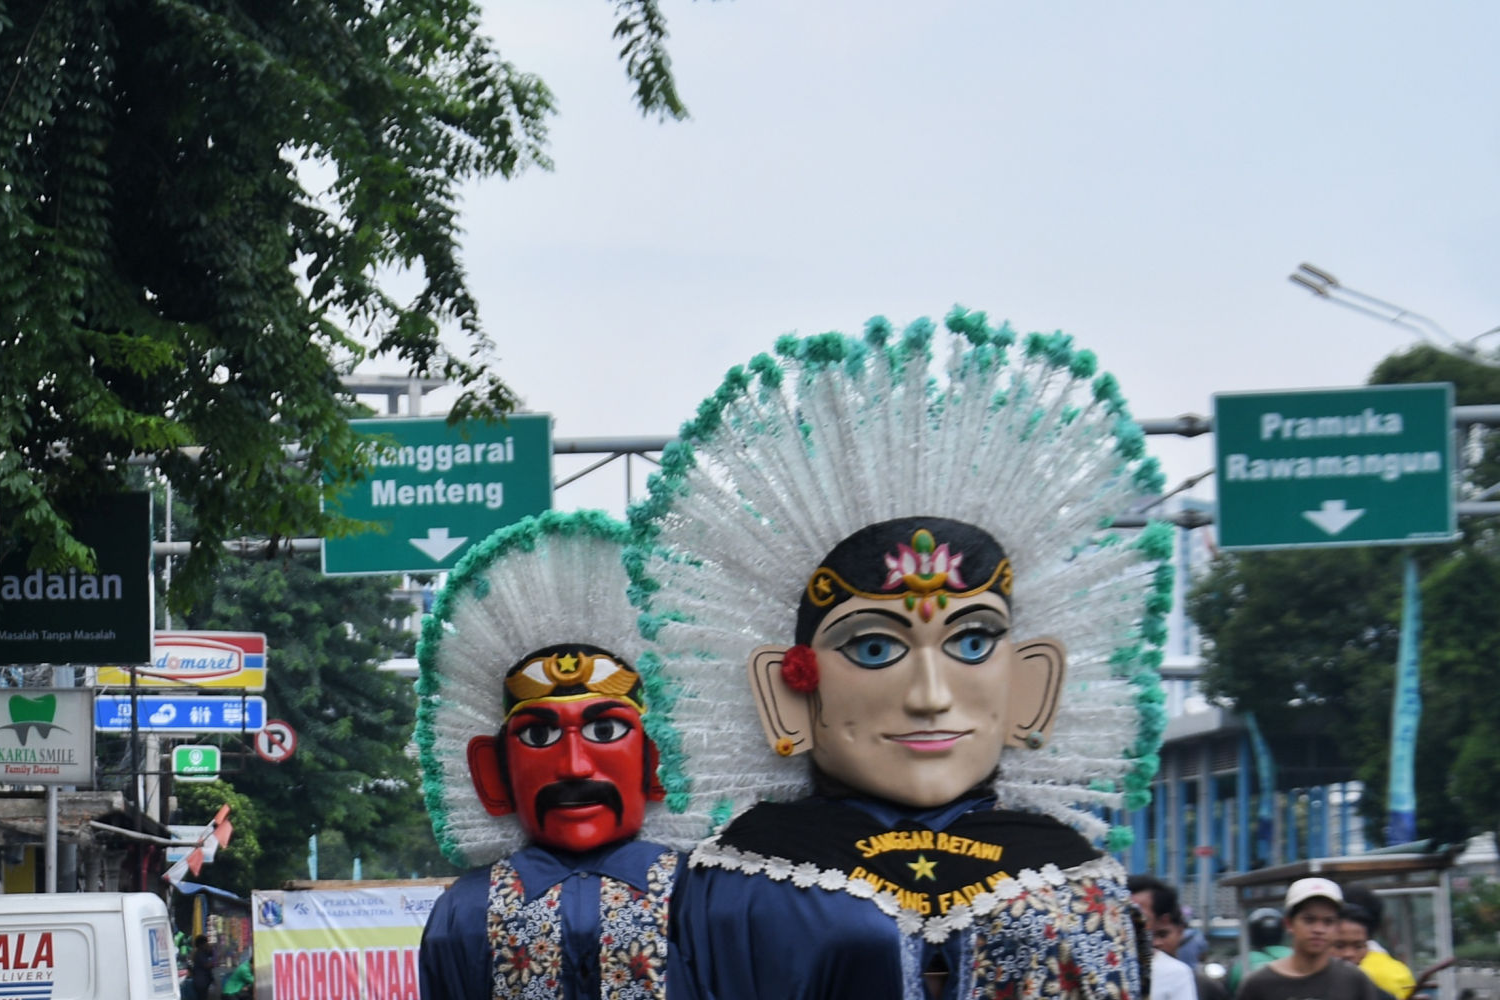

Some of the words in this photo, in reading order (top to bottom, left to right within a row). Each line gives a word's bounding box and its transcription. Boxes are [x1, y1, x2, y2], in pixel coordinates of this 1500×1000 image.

[1260, 408, 1404, 440] Pramuka
[1226, 451, 1441, 481] Rawamangun
[371, 478, 504, 509] Menteng
[41, 630, 72, 642] Tanpa
[74, 629, 115, 640] Masalah
[155, 652, 234, 670] domaret
[40, 749, 74, 762] SMILE
[5, 765, 30, 776] Family
[33, 765, 59, 775] Dental
[855, 831, 935, 858] SANGGAR
[937, 832, 1004, 862] BETAWI
